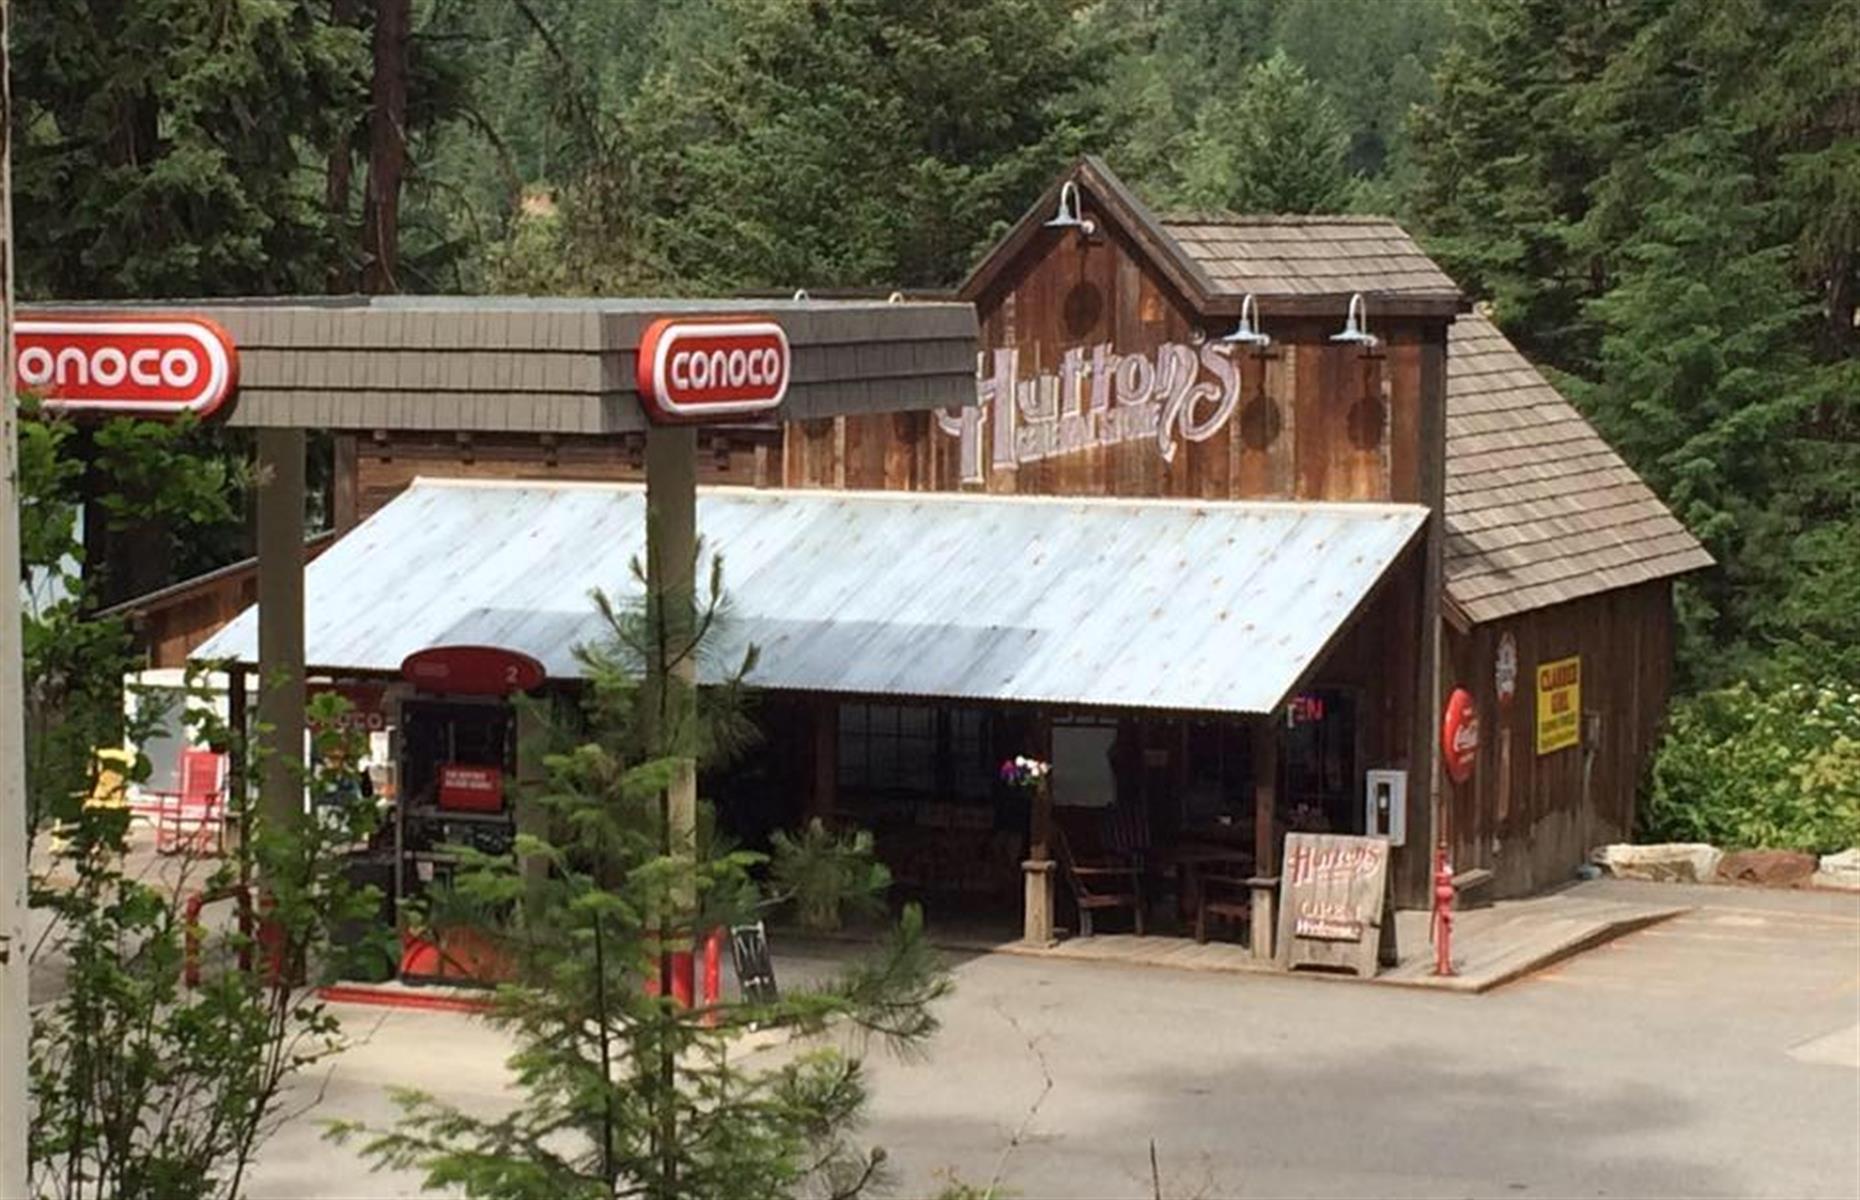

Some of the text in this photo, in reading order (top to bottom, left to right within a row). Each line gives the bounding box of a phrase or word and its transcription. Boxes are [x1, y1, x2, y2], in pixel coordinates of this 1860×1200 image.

[17, 346, 199, 388] ONOCO
[671, 347, 781, 391] CONOCO
[505, 666, 518, 683] 2
